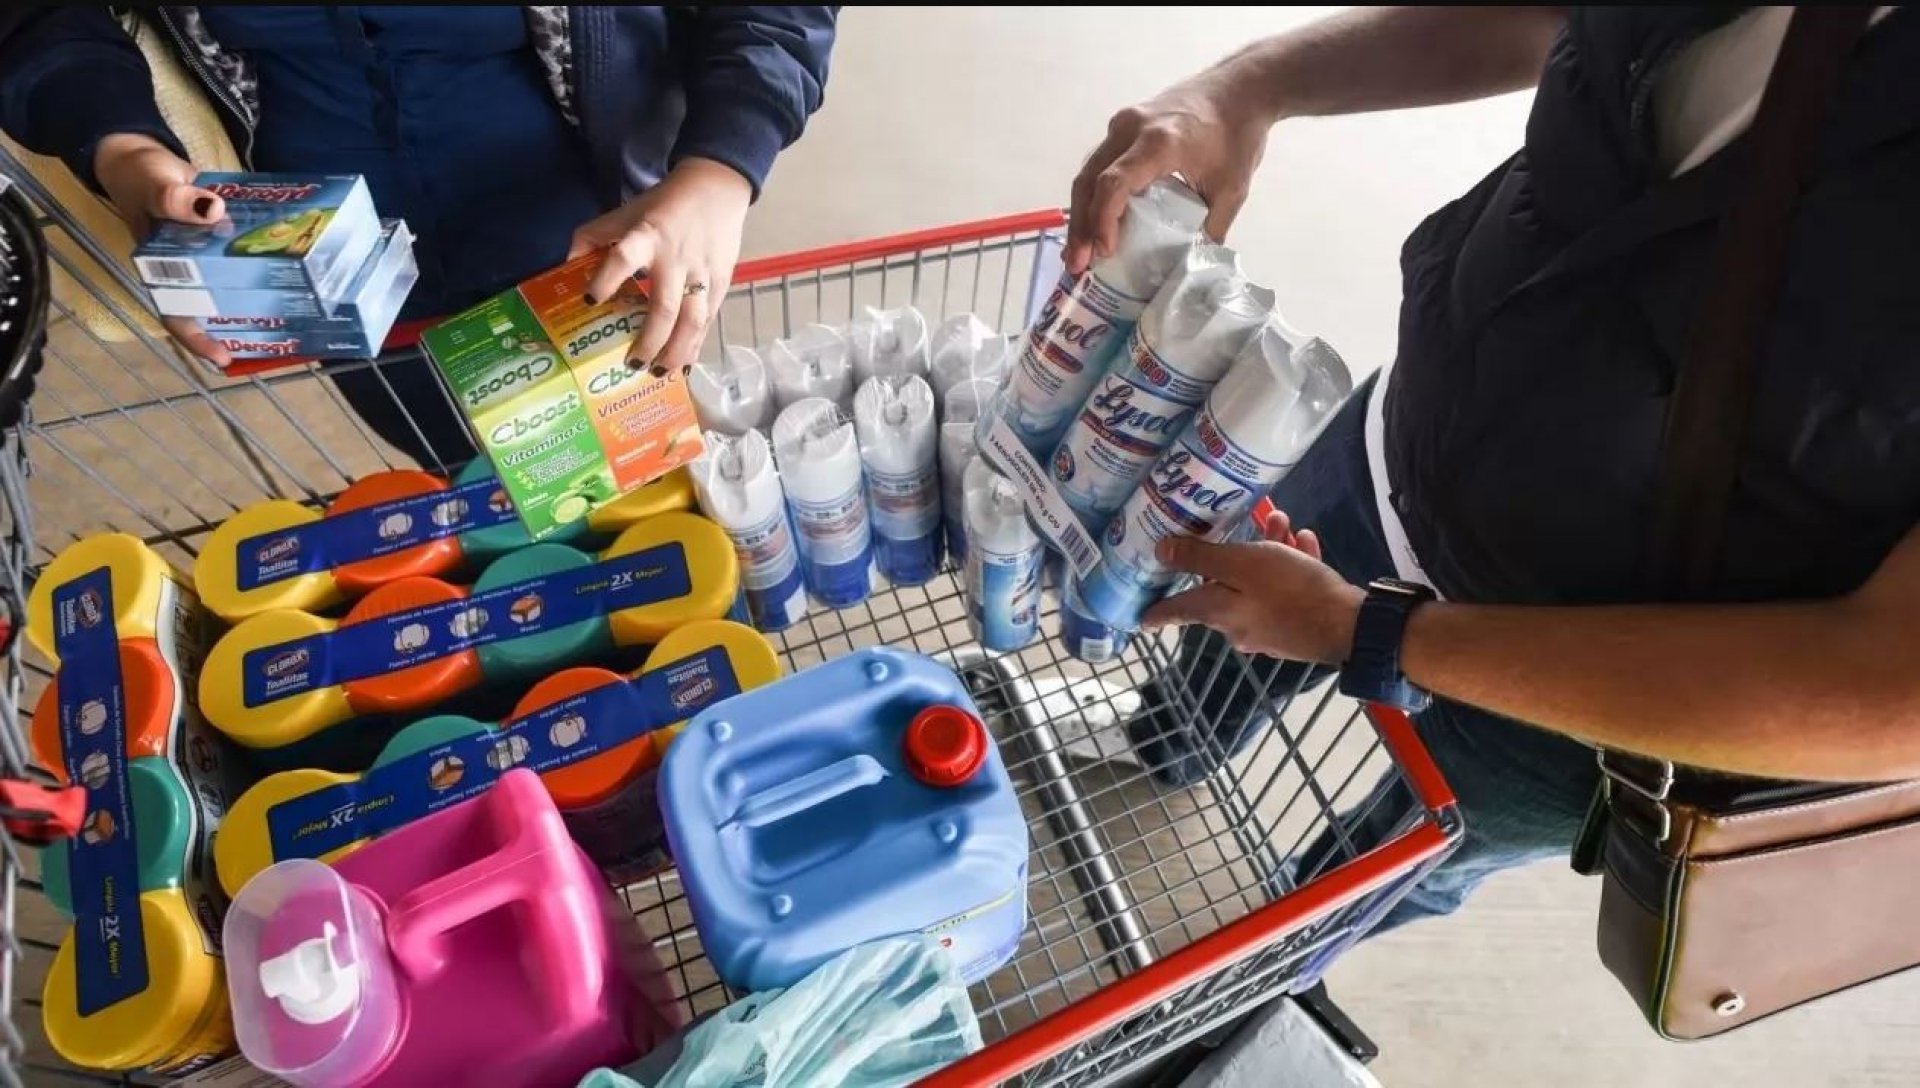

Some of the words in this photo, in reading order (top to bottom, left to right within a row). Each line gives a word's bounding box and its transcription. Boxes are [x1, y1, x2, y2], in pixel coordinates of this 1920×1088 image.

[470, 355, 554, 405] Cboost
[597, 382, 667, 418] Vitamina
[490, 392, 581, 446] Cboost
[1095, 372, 1195, 436] Lysol
[502, 430, 573, 468] Vitamina
[1151, 449, 1244, 512] Lysol
[611, 571, 633, 588] 2X
[331, 804, 355, 829] 2X
